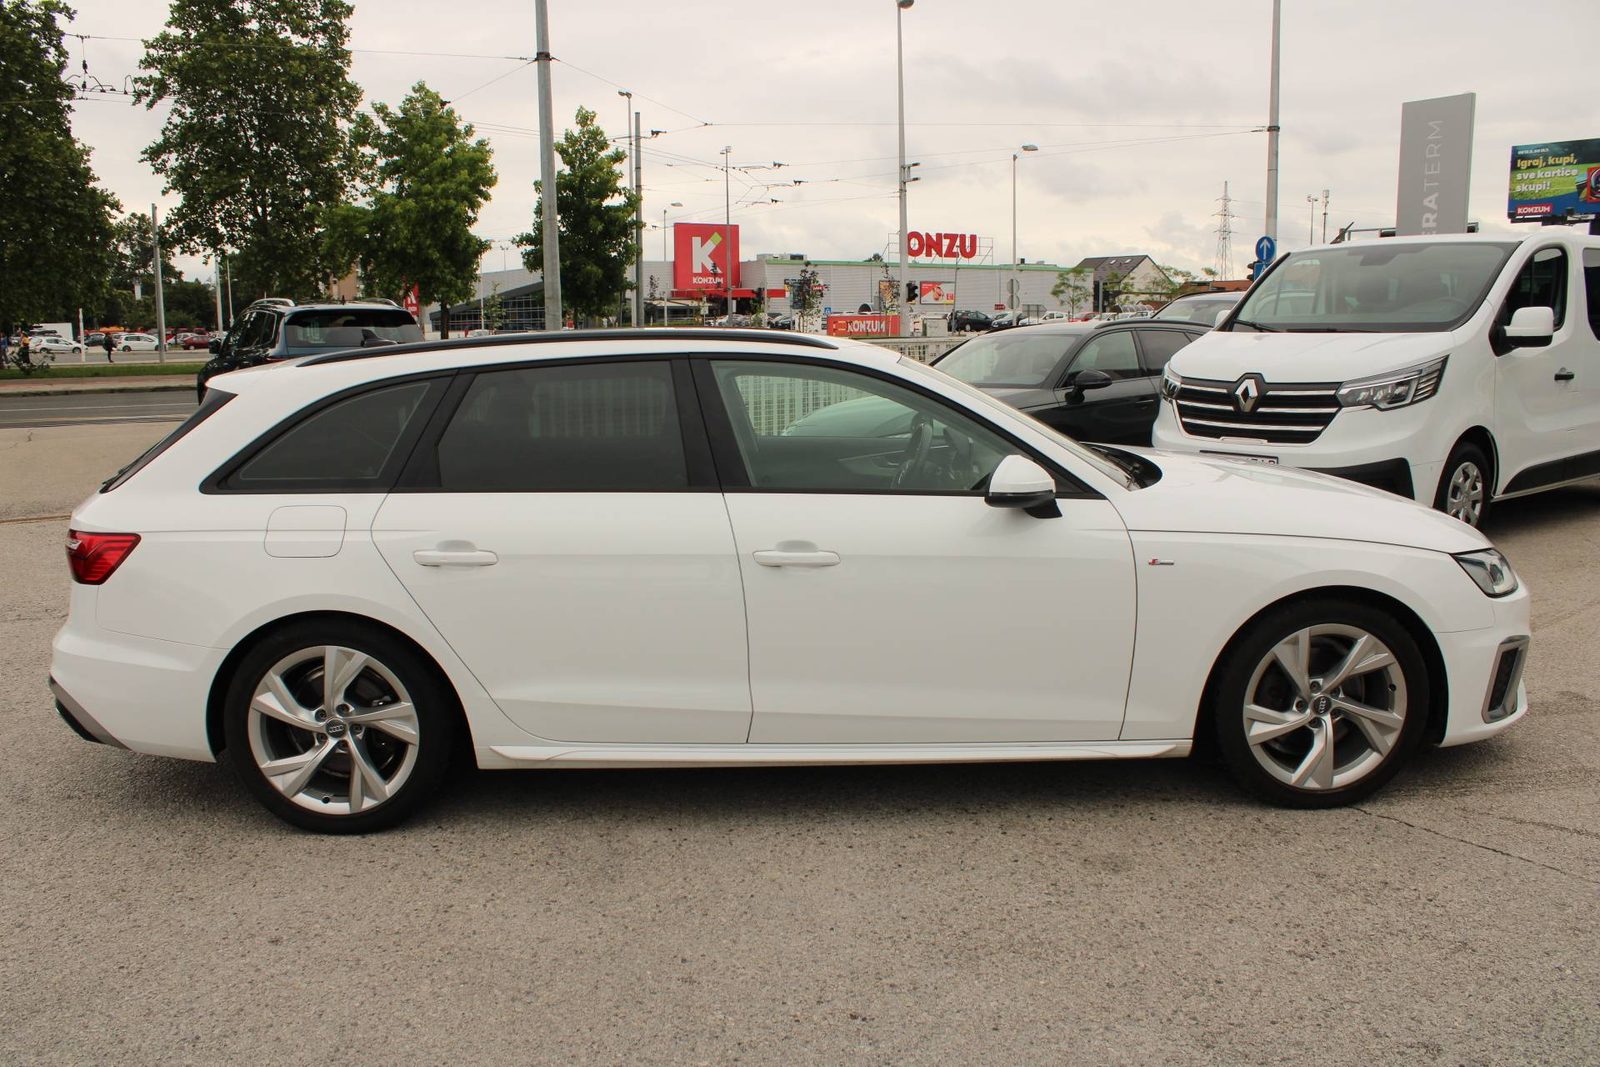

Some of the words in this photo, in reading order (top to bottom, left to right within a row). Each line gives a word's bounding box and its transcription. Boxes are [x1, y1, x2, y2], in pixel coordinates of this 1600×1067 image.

[1516, 156, 1547, 169] Igraj,
[1548, 153, 1578, 166] kupi,
[1516, 171, 1536, 180] sve
[1537, 168, 1579, 179] kartice
[1515, 181, 1551, 193] skupi!
[1517, 205, 1551, 214] KONZUM
[847, 319, 886, 333] KONZUM
